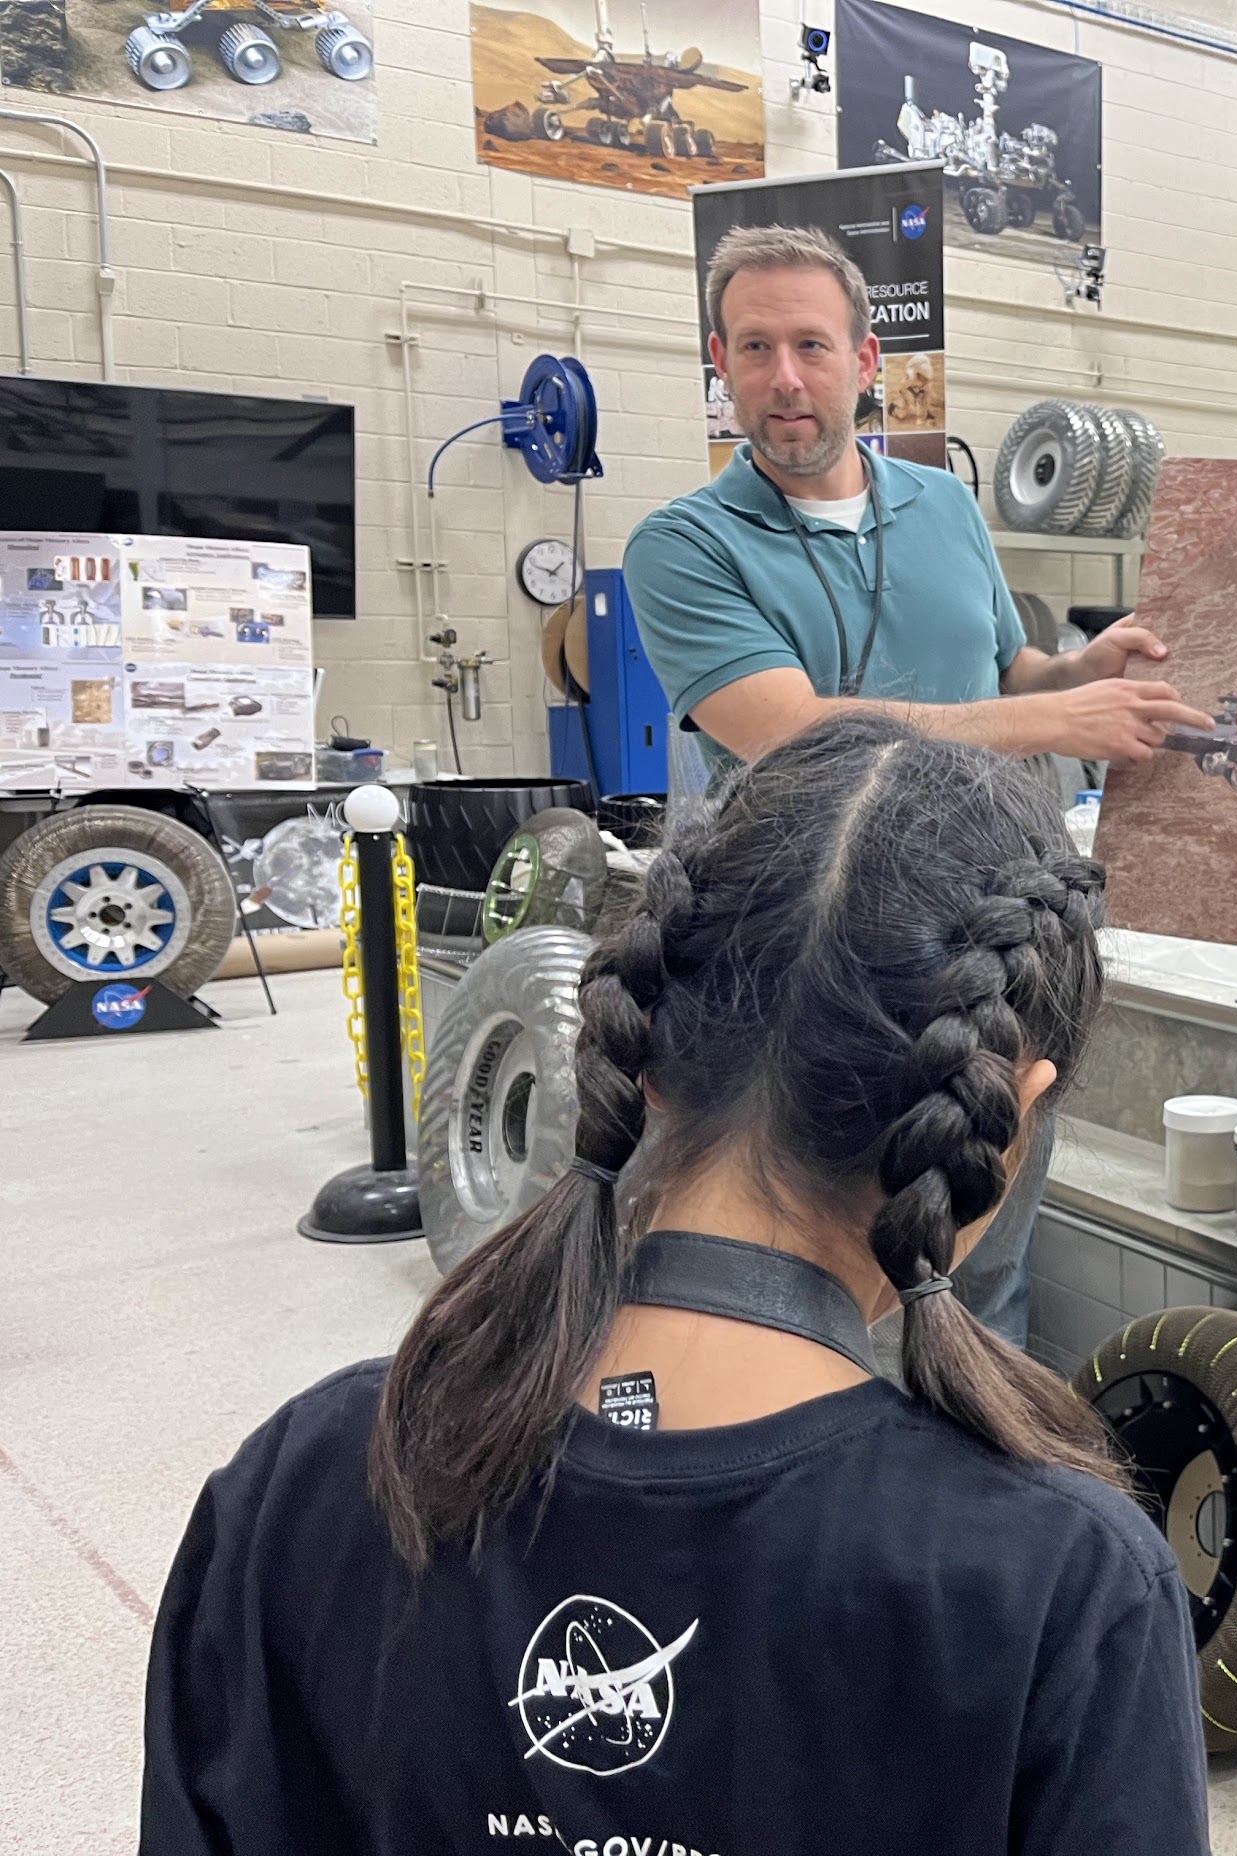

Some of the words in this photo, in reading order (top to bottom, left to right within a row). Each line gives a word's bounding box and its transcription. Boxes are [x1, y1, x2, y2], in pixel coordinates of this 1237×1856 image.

[901, 216, 926, 228] NASA
[867, 280, 928, 299] RESOURCE
[96, 1000, 142, 1013] NASA
[468, 1040, 501, 1154] GOODYEAR
[535, 1658, 661, 1719] NASA
